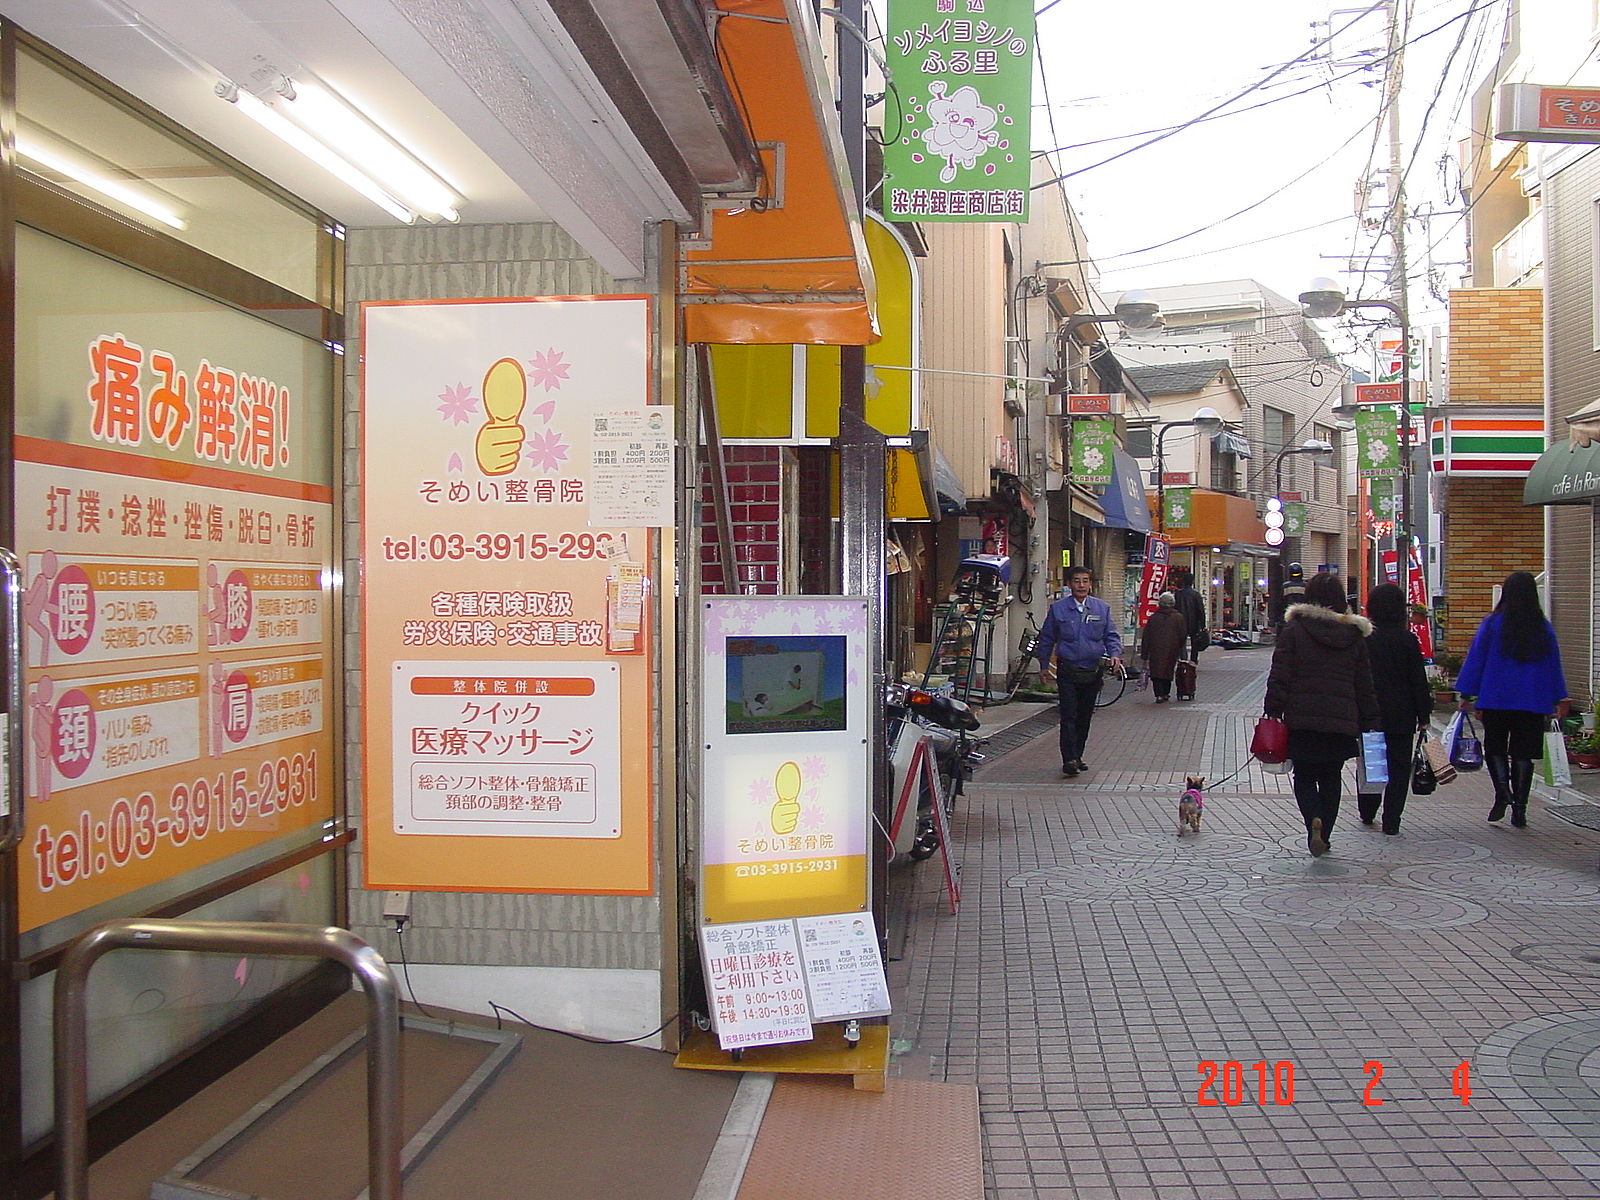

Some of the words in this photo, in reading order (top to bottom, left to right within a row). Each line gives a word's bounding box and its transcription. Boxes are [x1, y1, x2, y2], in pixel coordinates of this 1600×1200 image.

[894, 19, 1027, 56] ソメイヨシノの
[921, 51, 999, 75] ふる里
[892, 188, 1024, 215] 染井銀座商店街
[89, 333, 289, 470] 痛み解消!
[649, 449, 670, 457] 200円
[418, 480, 584, 504] そめい整骨院
[97, 570, 166, 586] いつも気になる
[57, 583, 89, 641] 腰
[226, 583, 249, 630] 膝
[431, 591, 574, 618] 各種保険取扱
[403, 620, 603, 646] 労災保険・交通事故
[453, 680, 549, 693] 整体院併設
[226, 683, 249, 731] 肩
[460, 702, 541, 724] クイック
[411, 727, 594, 756] 医療マッサージ
[417, 774, 590, 793] 総合ソフト整体・骨盤矯正
[445, 794, 562, 812] 頚部の調整・整骨
[34, 748, 318, 894] tel:03-3915-2931
[737, 834, 834, 854] そめい整骨院
[750, 859, 838, 877] 03-3915-2931
[706, 923, 791, 943] 総合ソフト整体
[725, 939, 779, 955] 骨盤矯正
[710, 951, 795, 973] 日曜日診療を
[714, 969, 799, 990] ご利用下さい
[717, 995, 735, 1008] 午前
[719, 1010, 738, 1024] 午後
